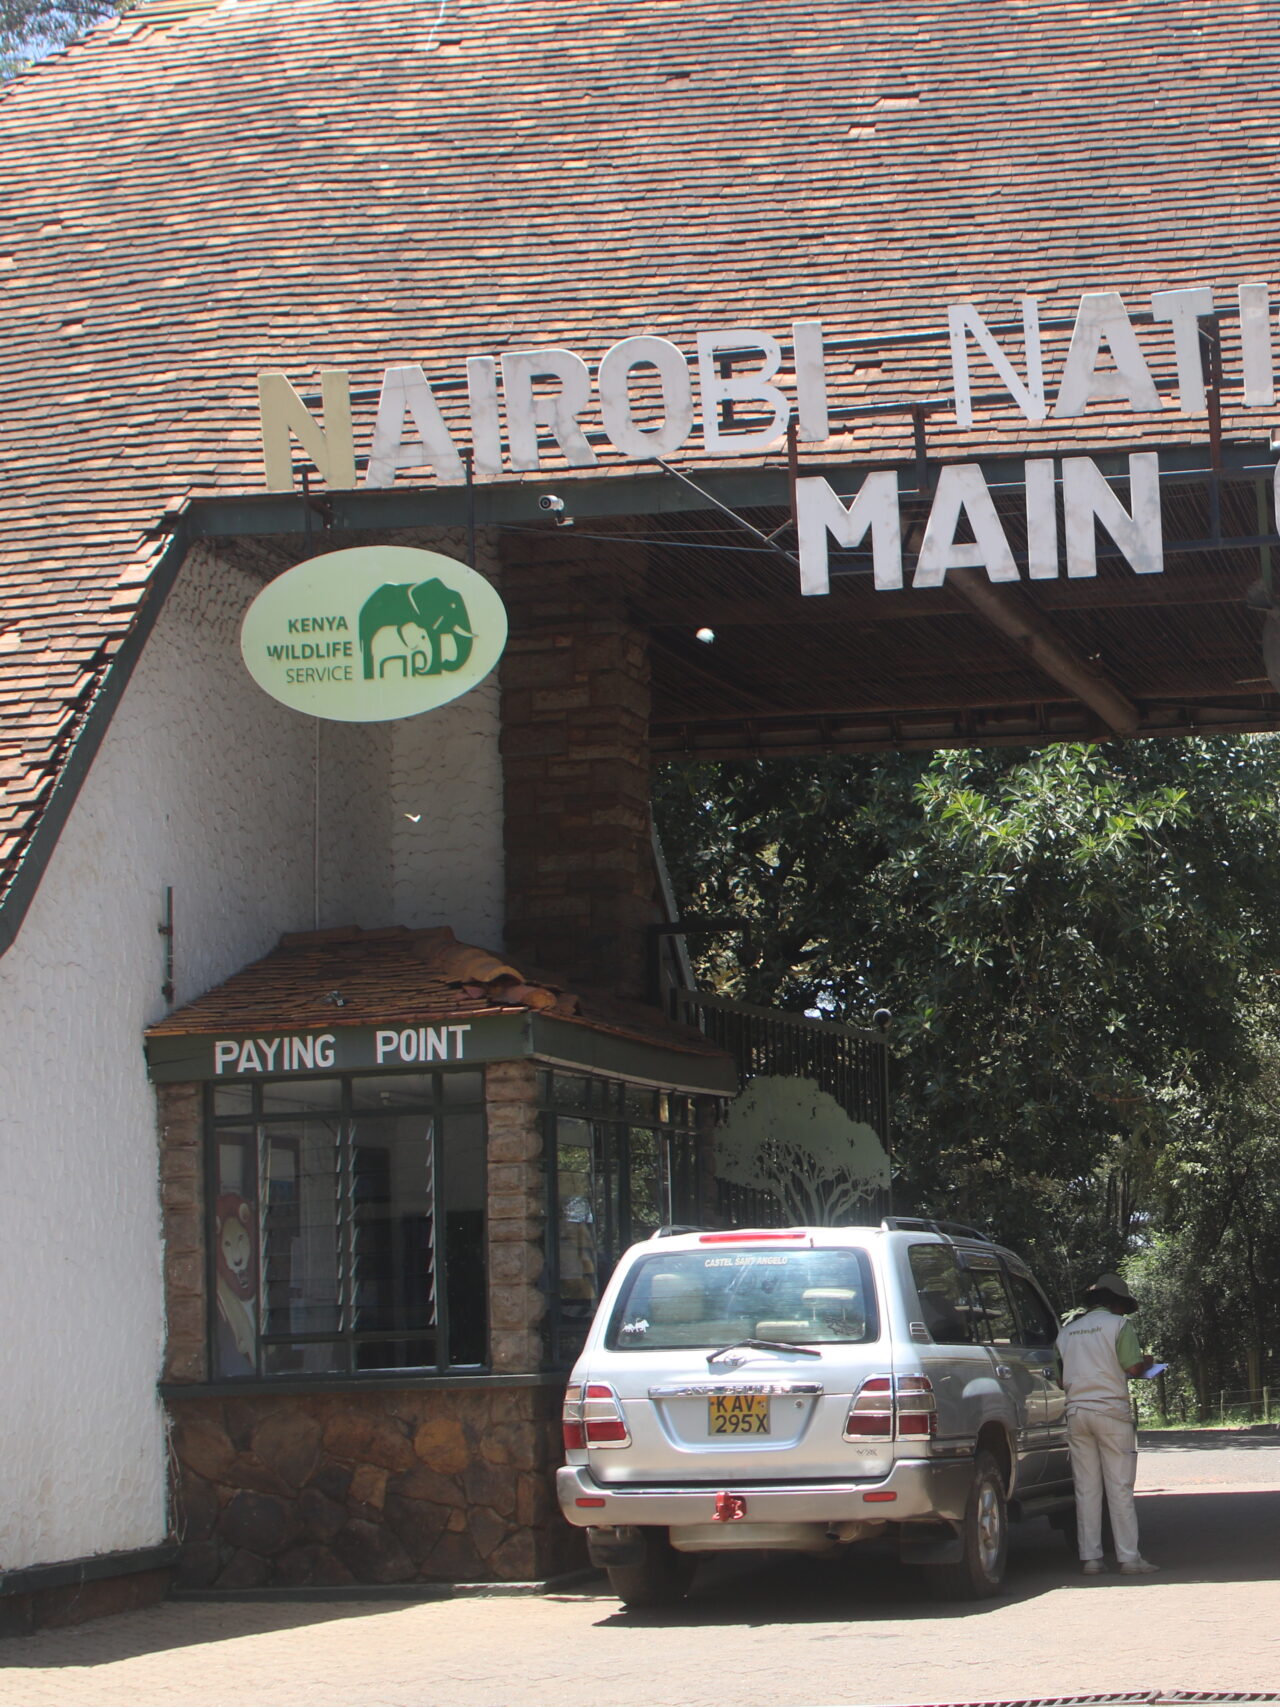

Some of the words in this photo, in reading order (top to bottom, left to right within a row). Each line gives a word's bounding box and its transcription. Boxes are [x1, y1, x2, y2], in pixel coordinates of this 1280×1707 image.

[257, 320, 828, 492] NAIROBI
[795, 453, 1164, 597] MAIN
[288, 615, 349, 633] KENYA
[266, 640, 353, 661] WILDLIFE
[286, 664, 353, 684] SERVICE
[213, 1033, 336, 1075] PAYING
[375, 1024, 472, 1064] POINT
[704, 1257, 733, 1268] CASTEL
[715, 1395, 757, 1412] KAV
[715, 1413, 767, 1434] 295X
